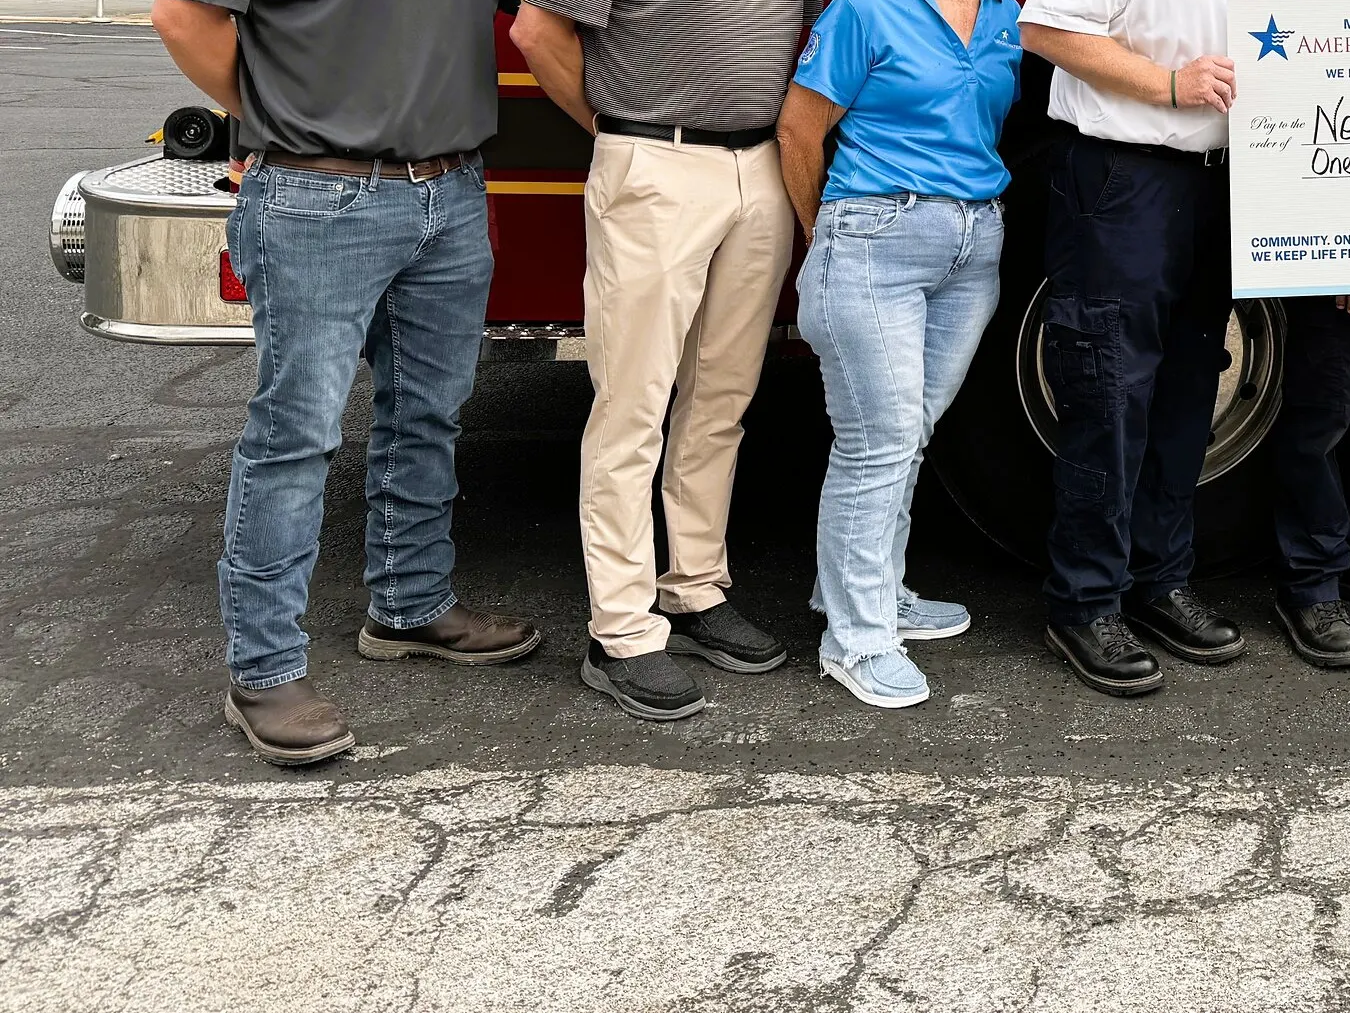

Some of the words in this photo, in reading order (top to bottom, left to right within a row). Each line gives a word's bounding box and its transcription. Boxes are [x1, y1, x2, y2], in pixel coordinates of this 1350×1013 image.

[1325, 68, 1344, 78] WE
[1250, 116, 1277, 135] Pay
[1278, 120, 1289, 129] to
[1289, 119, 1306, 129] the
[1249, 138, 1278, 149] order
[1279, 136, 1292, 153] of
[1250, 235, 1330, 248] COMMUNITY.
[1251, 251, 1272, 262] WE
[1275, 250, 1308, 261] KEEP
[1311, 249, 1336, 260] LIFE
